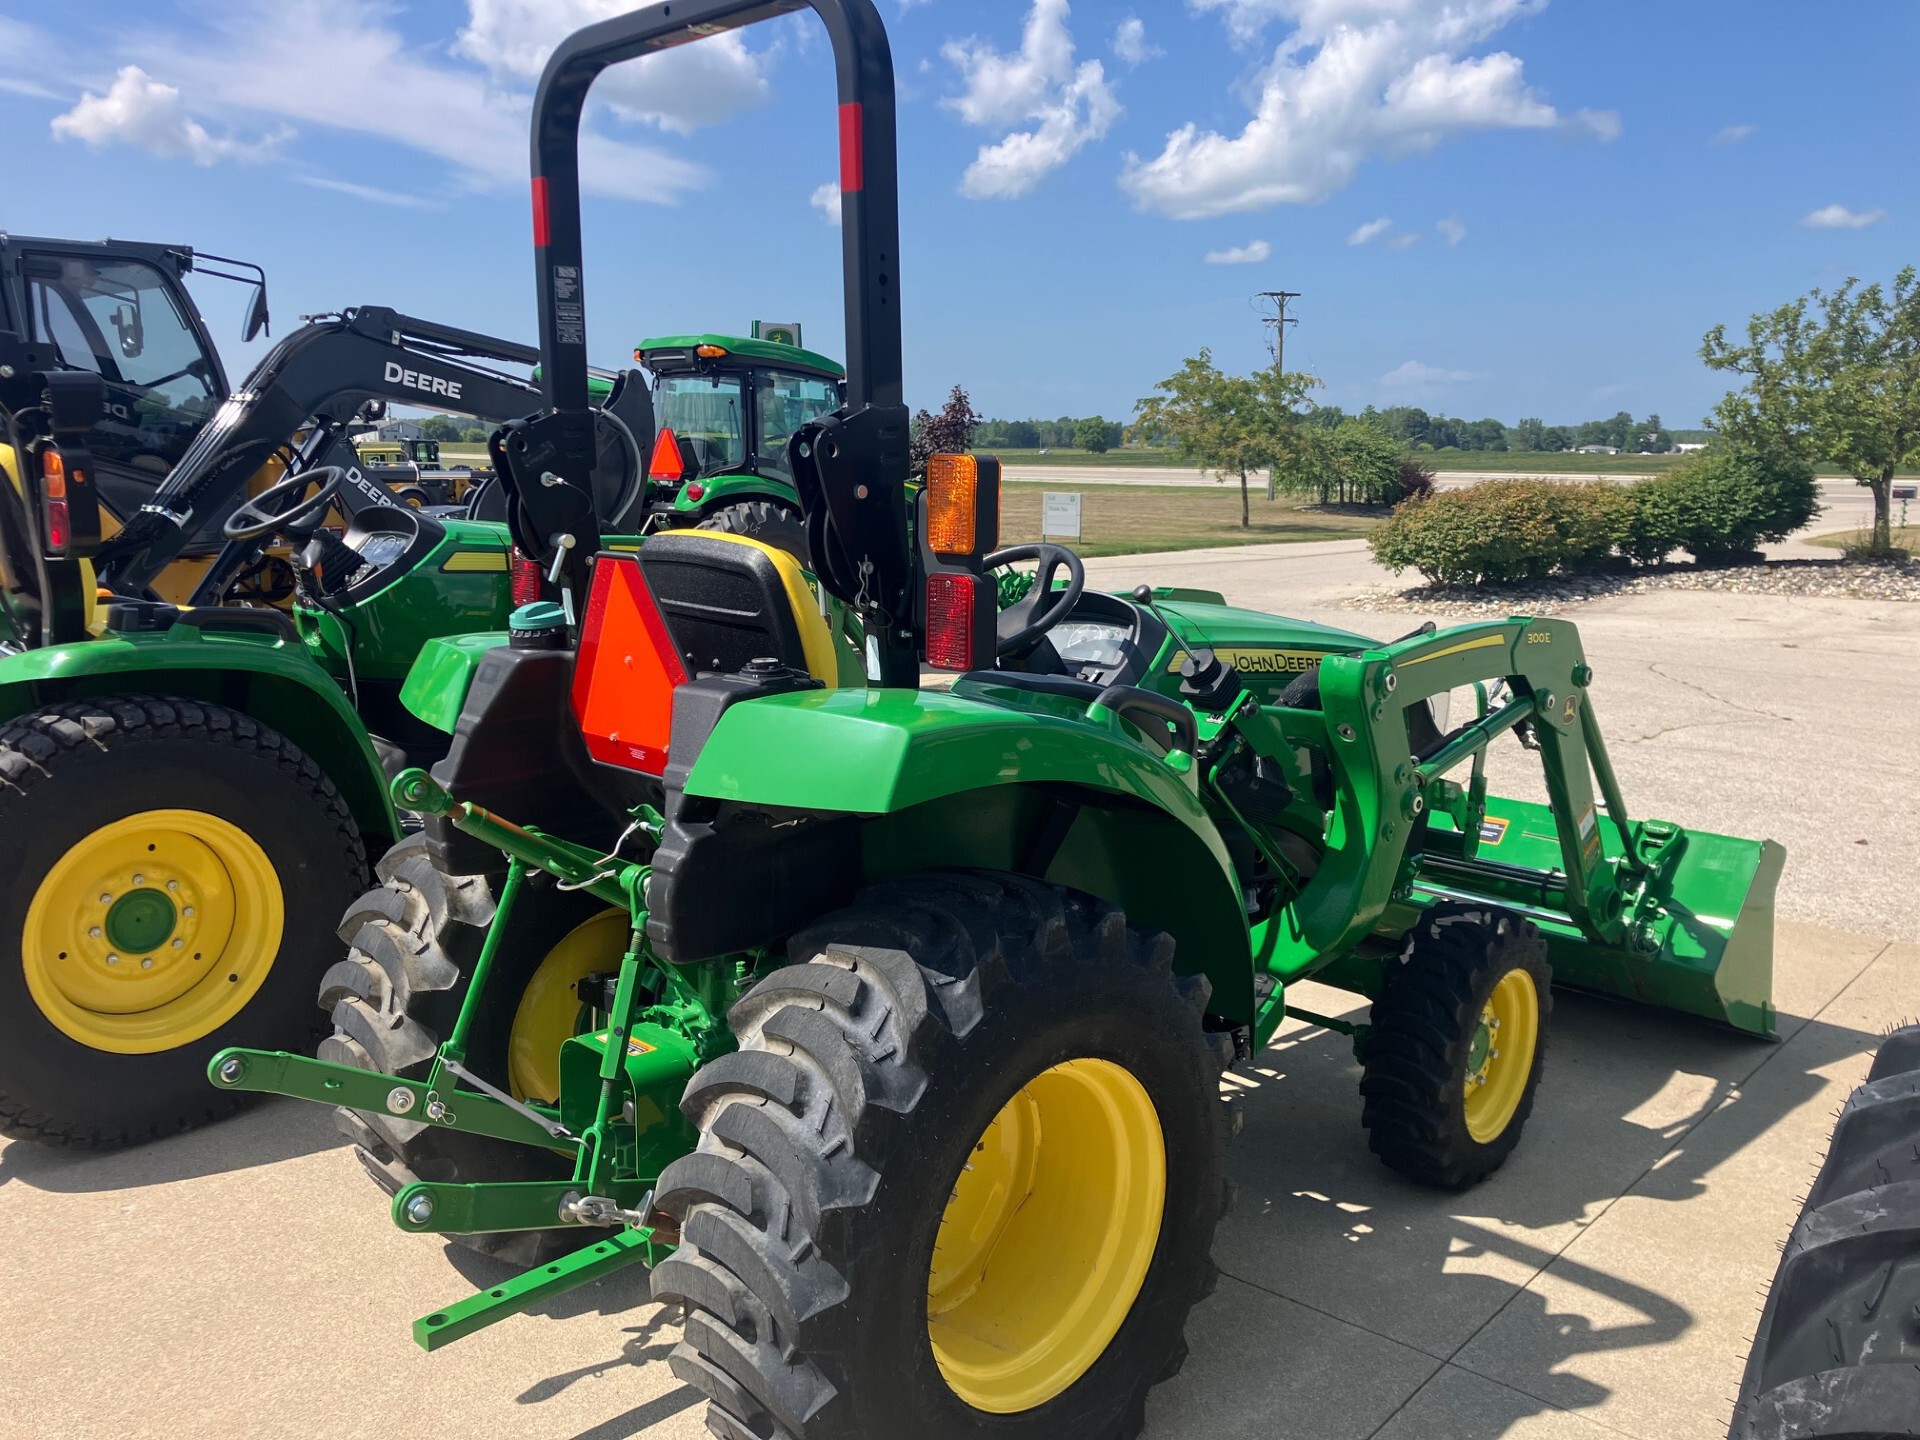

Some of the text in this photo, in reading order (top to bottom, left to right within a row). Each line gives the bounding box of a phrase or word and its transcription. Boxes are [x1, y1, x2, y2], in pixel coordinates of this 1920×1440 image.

[384, 361, 462, 400] DEERE
[345, 466, 399, 509] DEER
[1527, 632, 1551, 644] 300E
[1232, 653, 1273, 670] JOHN
